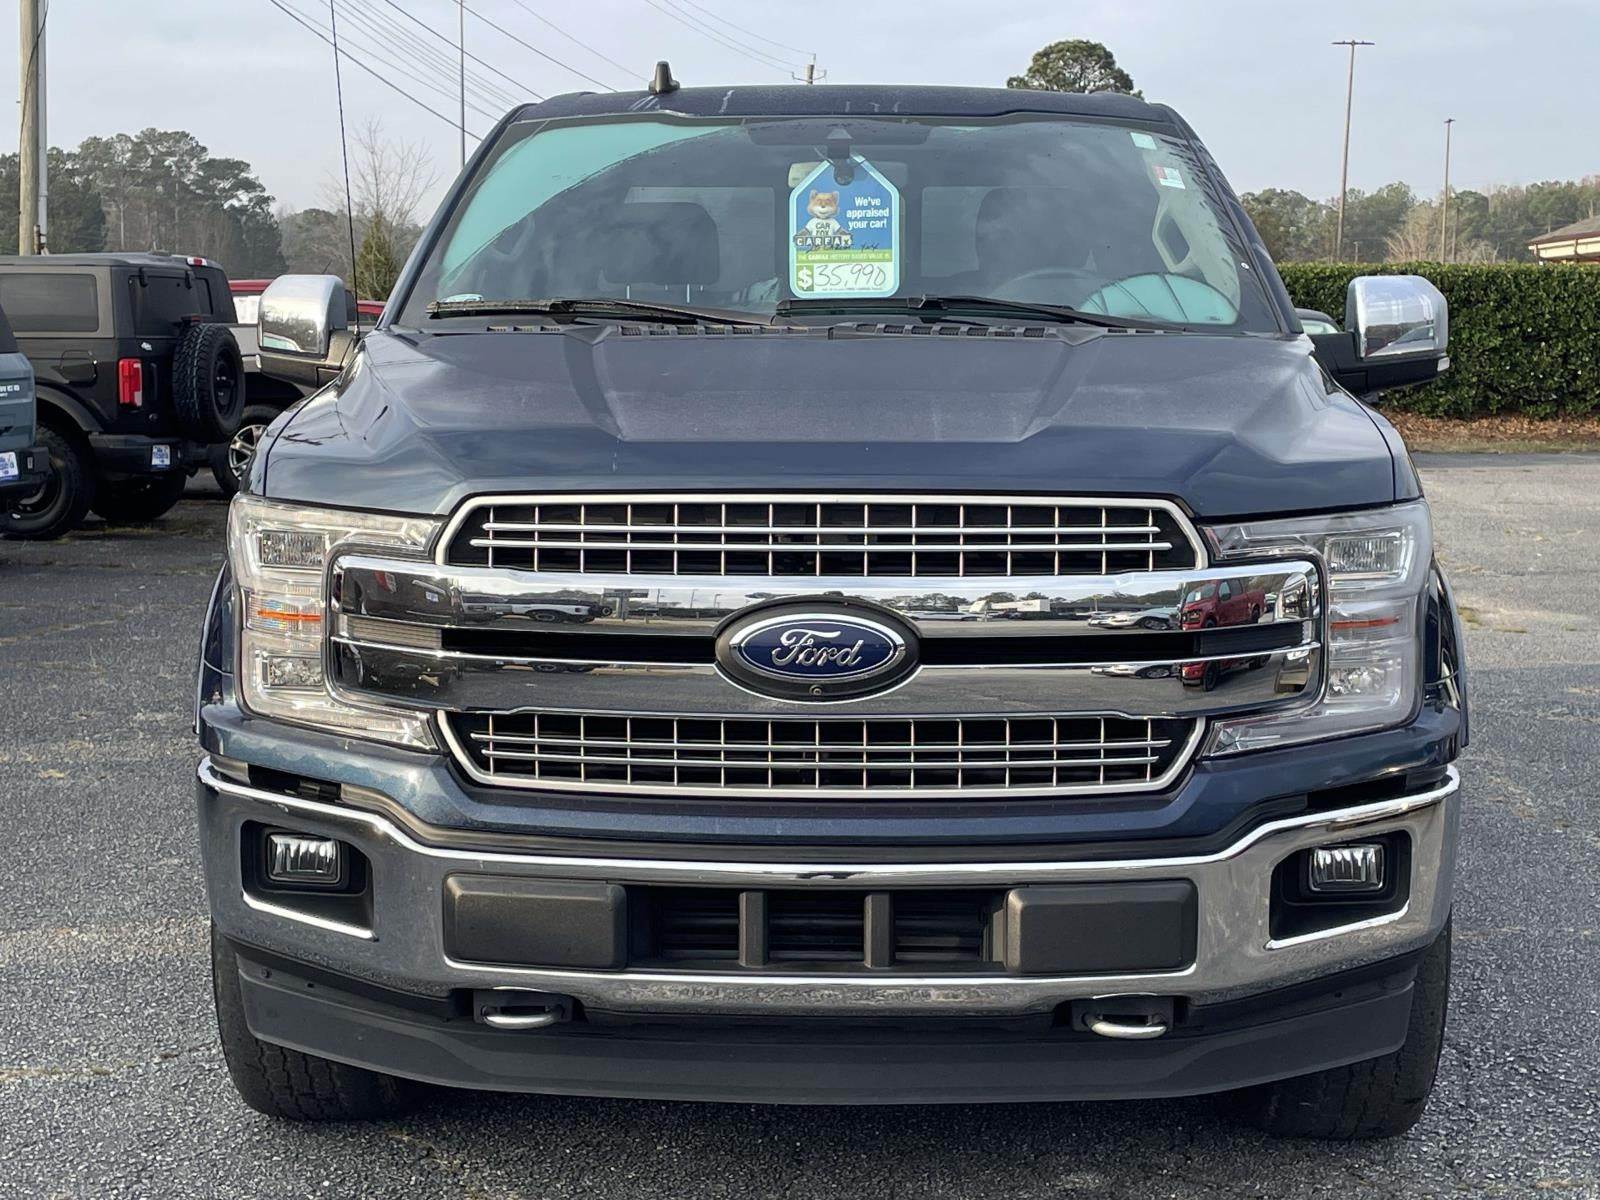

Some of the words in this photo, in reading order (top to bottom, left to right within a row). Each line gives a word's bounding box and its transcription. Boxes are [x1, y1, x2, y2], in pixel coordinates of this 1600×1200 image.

[854, 197, 881, 206] We've
[846, 208, 889, 219] appraised
[815, 222, 831, 230] CAR
[848, 220, 868, 230] your
[869, 219, 887, 228] car!
[796, 236, 852, 247] CARFAX
[771, 628, 864, 666] Ford
